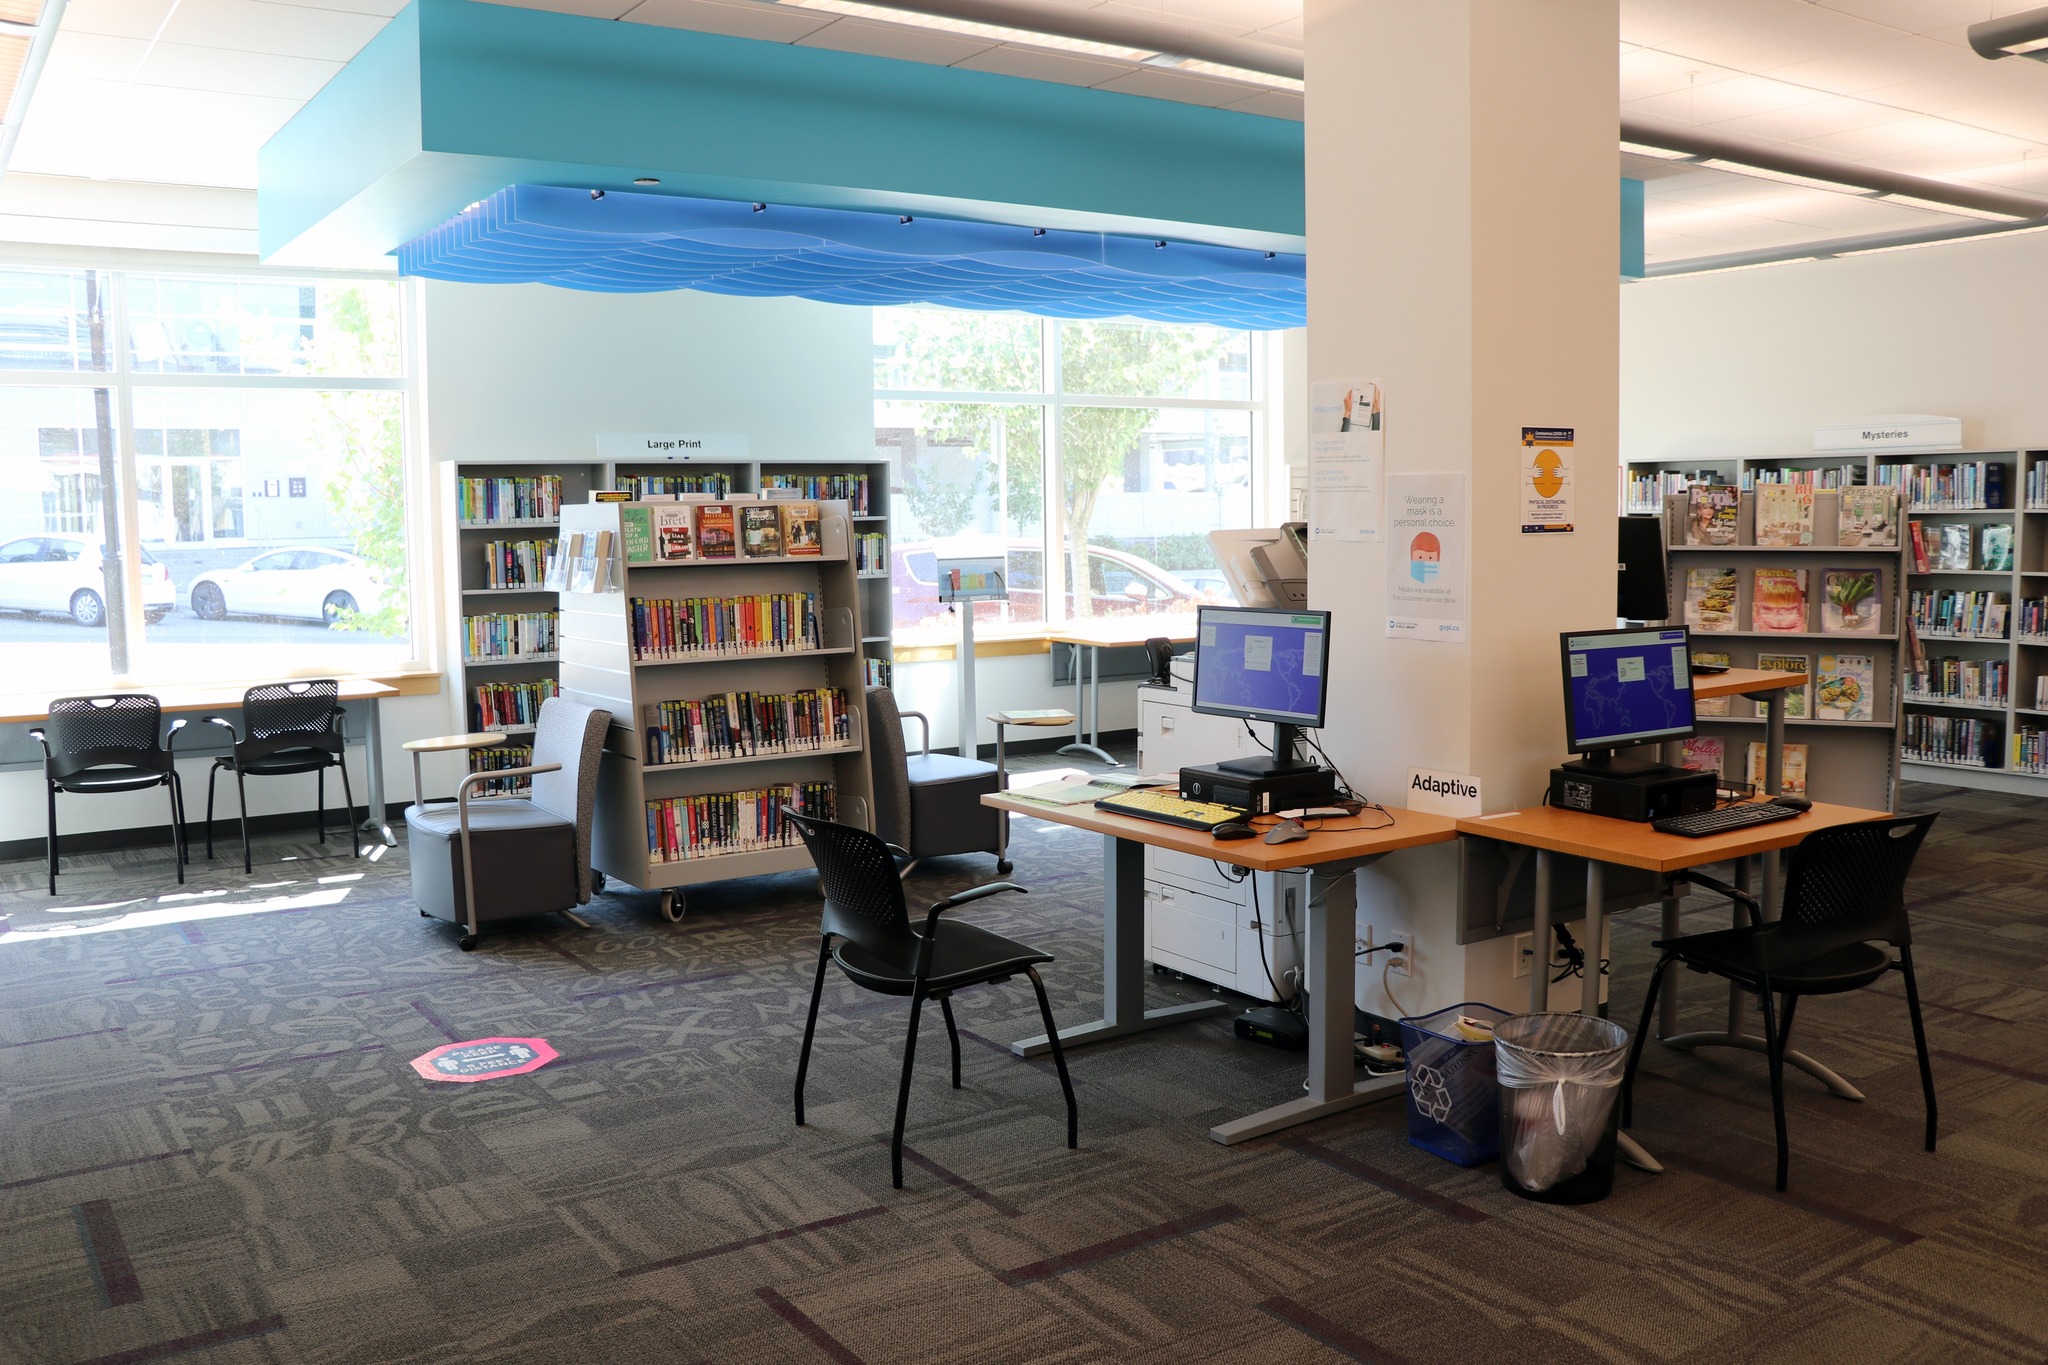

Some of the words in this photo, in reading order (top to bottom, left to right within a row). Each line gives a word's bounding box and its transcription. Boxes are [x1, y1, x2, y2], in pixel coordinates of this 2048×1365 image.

[1862, 430, 1909, 440] Mysteries
[647, 440, 675, 450] Large
[678, 440, 702, 448] Print
[1795, 484, 1812, 494] BH
[1405, 495, 1437, 506] Wearing
[1803, 495, 1812, 504] G
[1407, 507, 1427, 515] mask
[1429, 507, 1436, 515] is
[660, 516, 686, 526] Brett
[1394, 518, 1427, 528] personal
[1428, 518, 1456, 528] choice.
[1760, 657, 1807, 672] explore
[1683, 739, 1721, 754] Mollie
[1411, 774, 1477, 798] Adaptive
[452, 1045, 502, 1056] PLEASE
[463, 1050, 497, 1058] KEEP
[459, 1059, 526, 1073] DISTANCE
[478, 1057, 512, 1067] FEET
